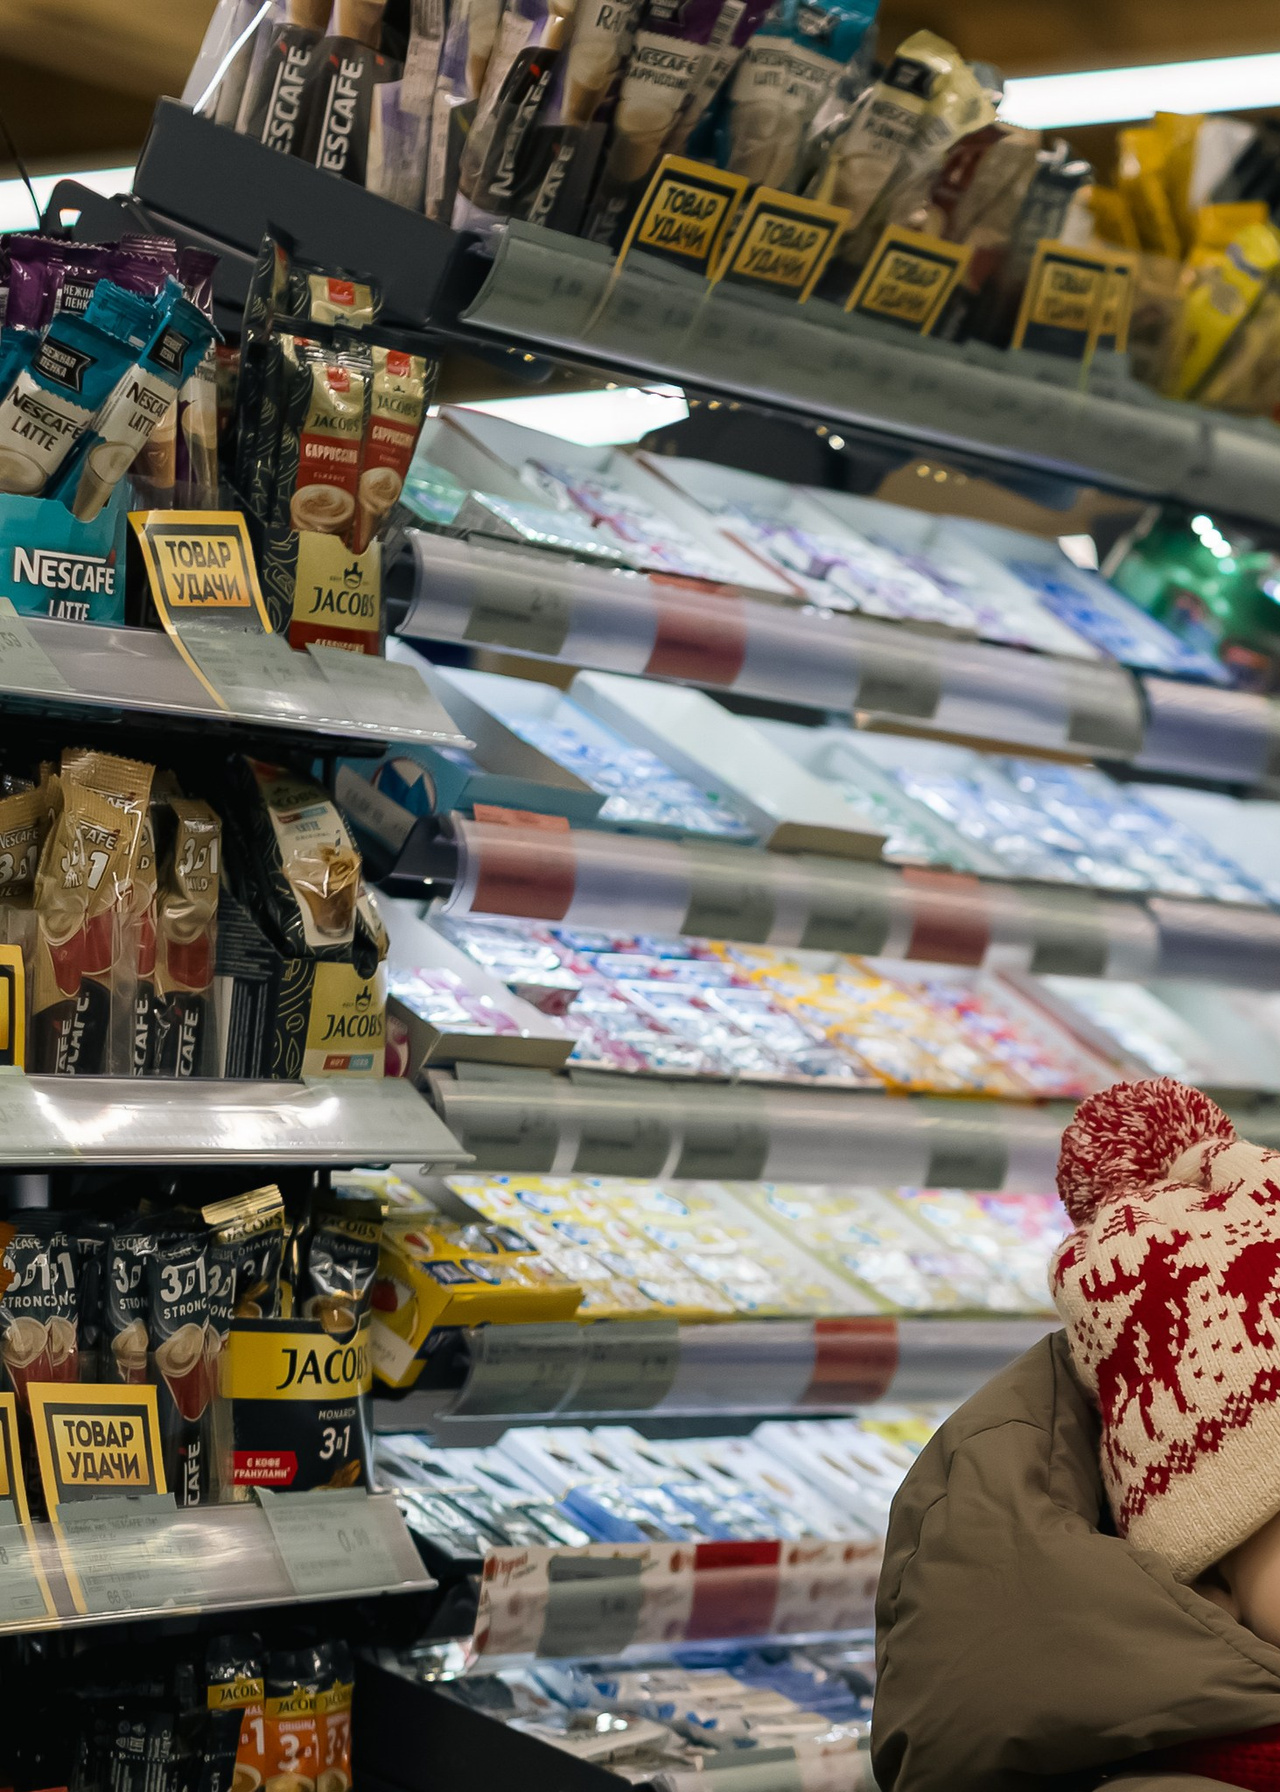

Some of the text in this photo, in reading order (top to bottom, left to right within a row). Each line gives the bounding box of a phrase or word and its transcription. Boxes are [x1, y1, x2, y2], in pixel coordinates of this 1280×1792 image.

[262, 46, 313, 154] ESCAFE
[316, 57, 364, 171] ESCAFE
[662, 186, 720, 221] ТОВАР
[648, 215, 707, 249] УДАЧИ
[63, 284, 94, 300] НЕЖНА
[65, 296, 89, 310] ПЕНК
[126, 381, 170, 418] NESCAF
[12, 416, 59, 452] LATTE
[311, 413, 361, 432] JACOBS
[165, 540, 231, 568] ТОВАР
[172, 573, 242, 603] УДАЧИ
[308, 586, 375, 618] JACOBS
[49, 599, 90, 621] LATTE
[321, 1013, 383, 1041] JACOBS
[276, 1345, 369, 1390] JACOBS
[63, 1420, 134, 1448] ТОВАР
[67, 1451, 140, 1481] УДАЧИ
